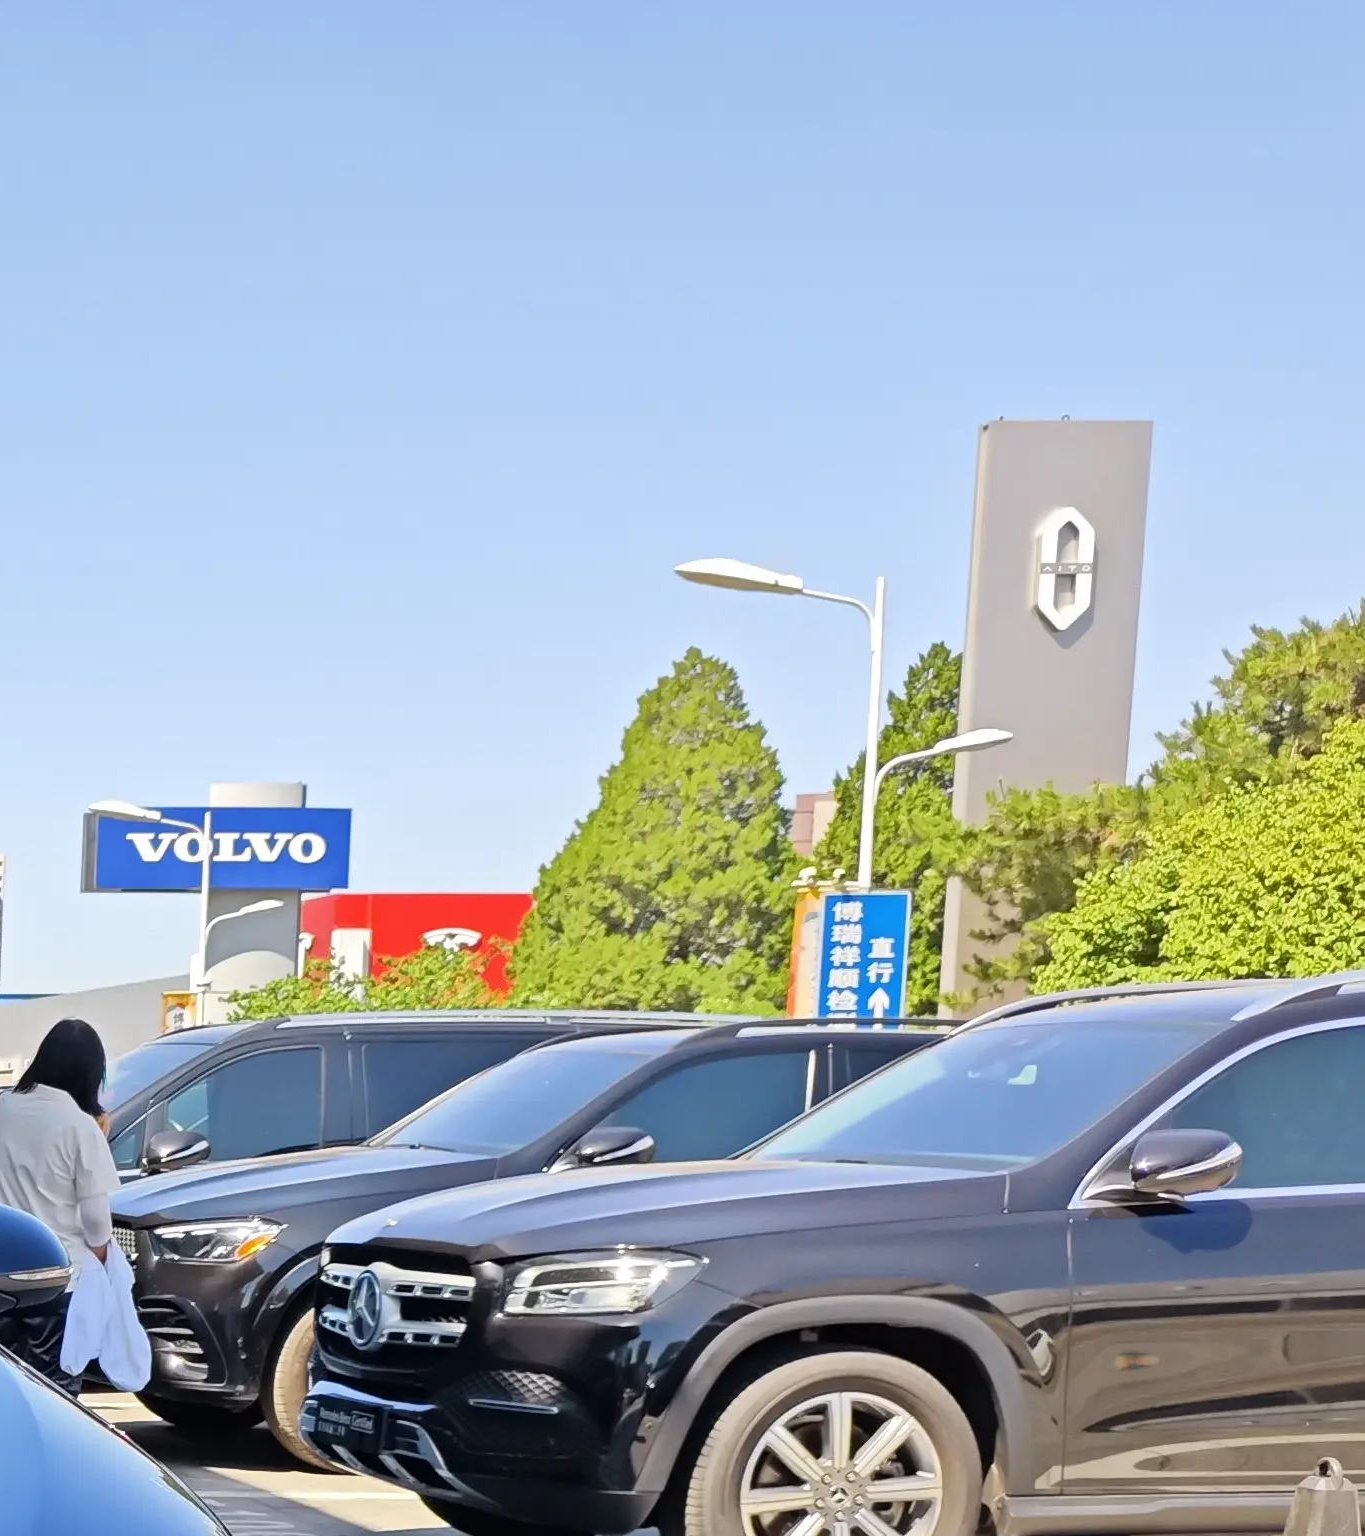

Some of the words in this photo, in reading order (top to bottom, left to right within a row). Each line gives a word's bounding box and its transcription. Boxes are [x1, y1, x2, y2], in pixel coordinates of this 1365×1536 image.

[1042, 564, 1091, 572] AITO
[126, 832, 327, 864] VOLVO
[866, 937, 895, 984] 直行
